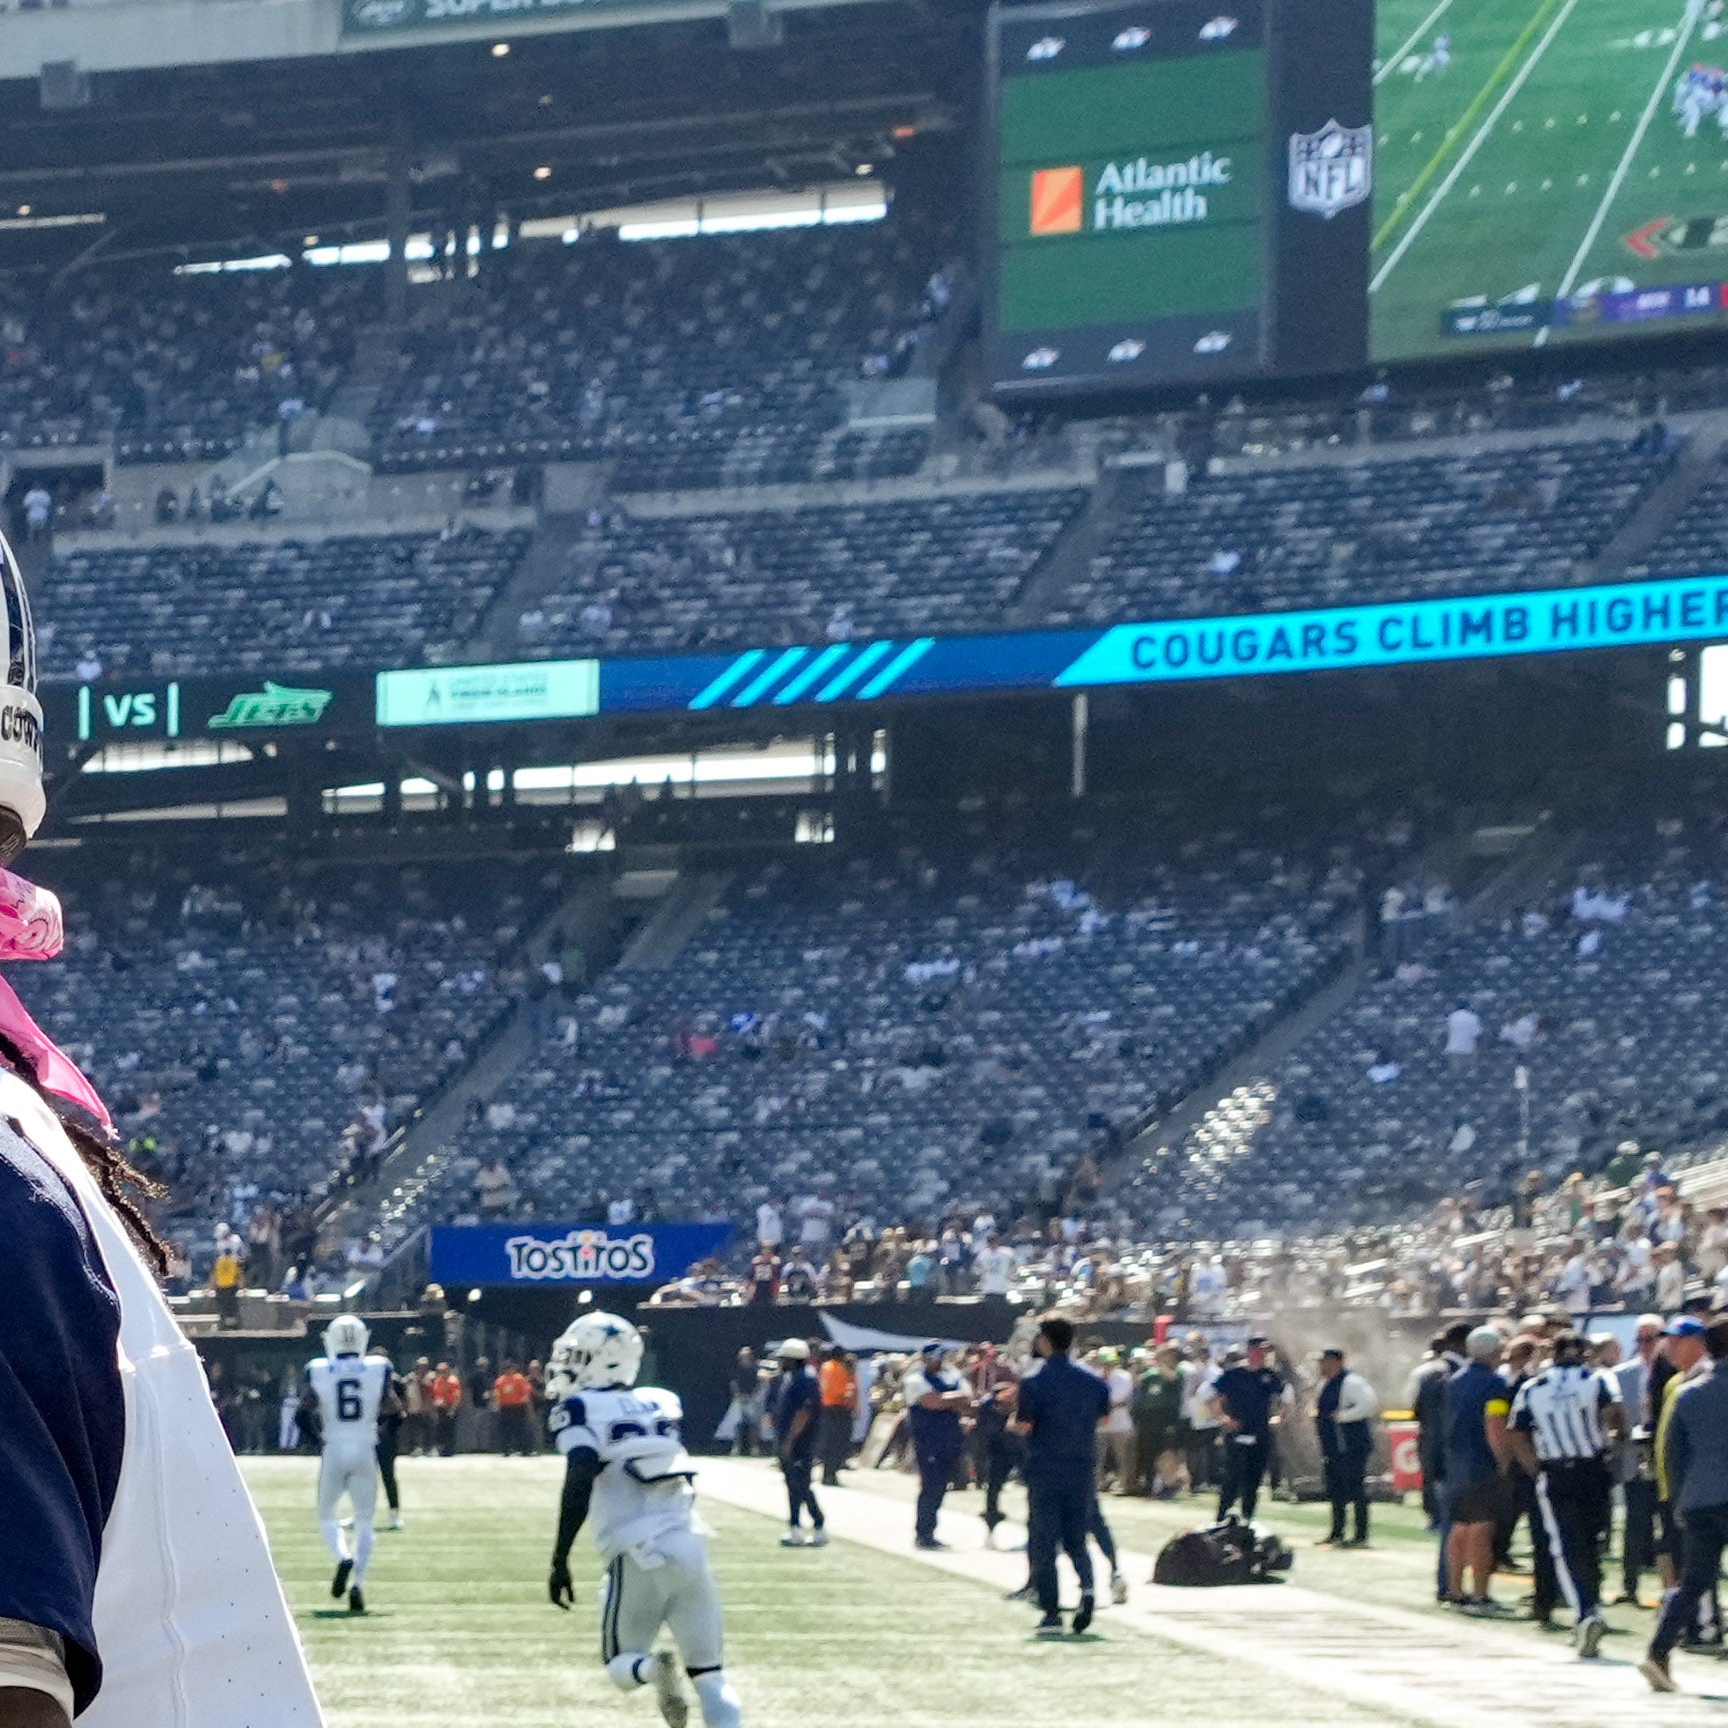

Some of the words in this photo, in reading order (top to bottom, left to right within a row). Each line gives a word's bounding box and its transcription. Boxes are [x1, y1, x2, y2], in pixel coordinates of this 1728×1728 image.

[1095, 151, 1232, 195] Atlantic
[1296, 156, 1366, 201] NFL
[1094, 188, 1207, 230] Health
[1131, 614, 1359, 671] COUGARS
[1377, 605, 1531, 655] CLIMB
[104, 693, 156, 726] VS
[509, 1237, 650, 1275] TOSTITOS
[336, 1378, 362, 1422] 6
